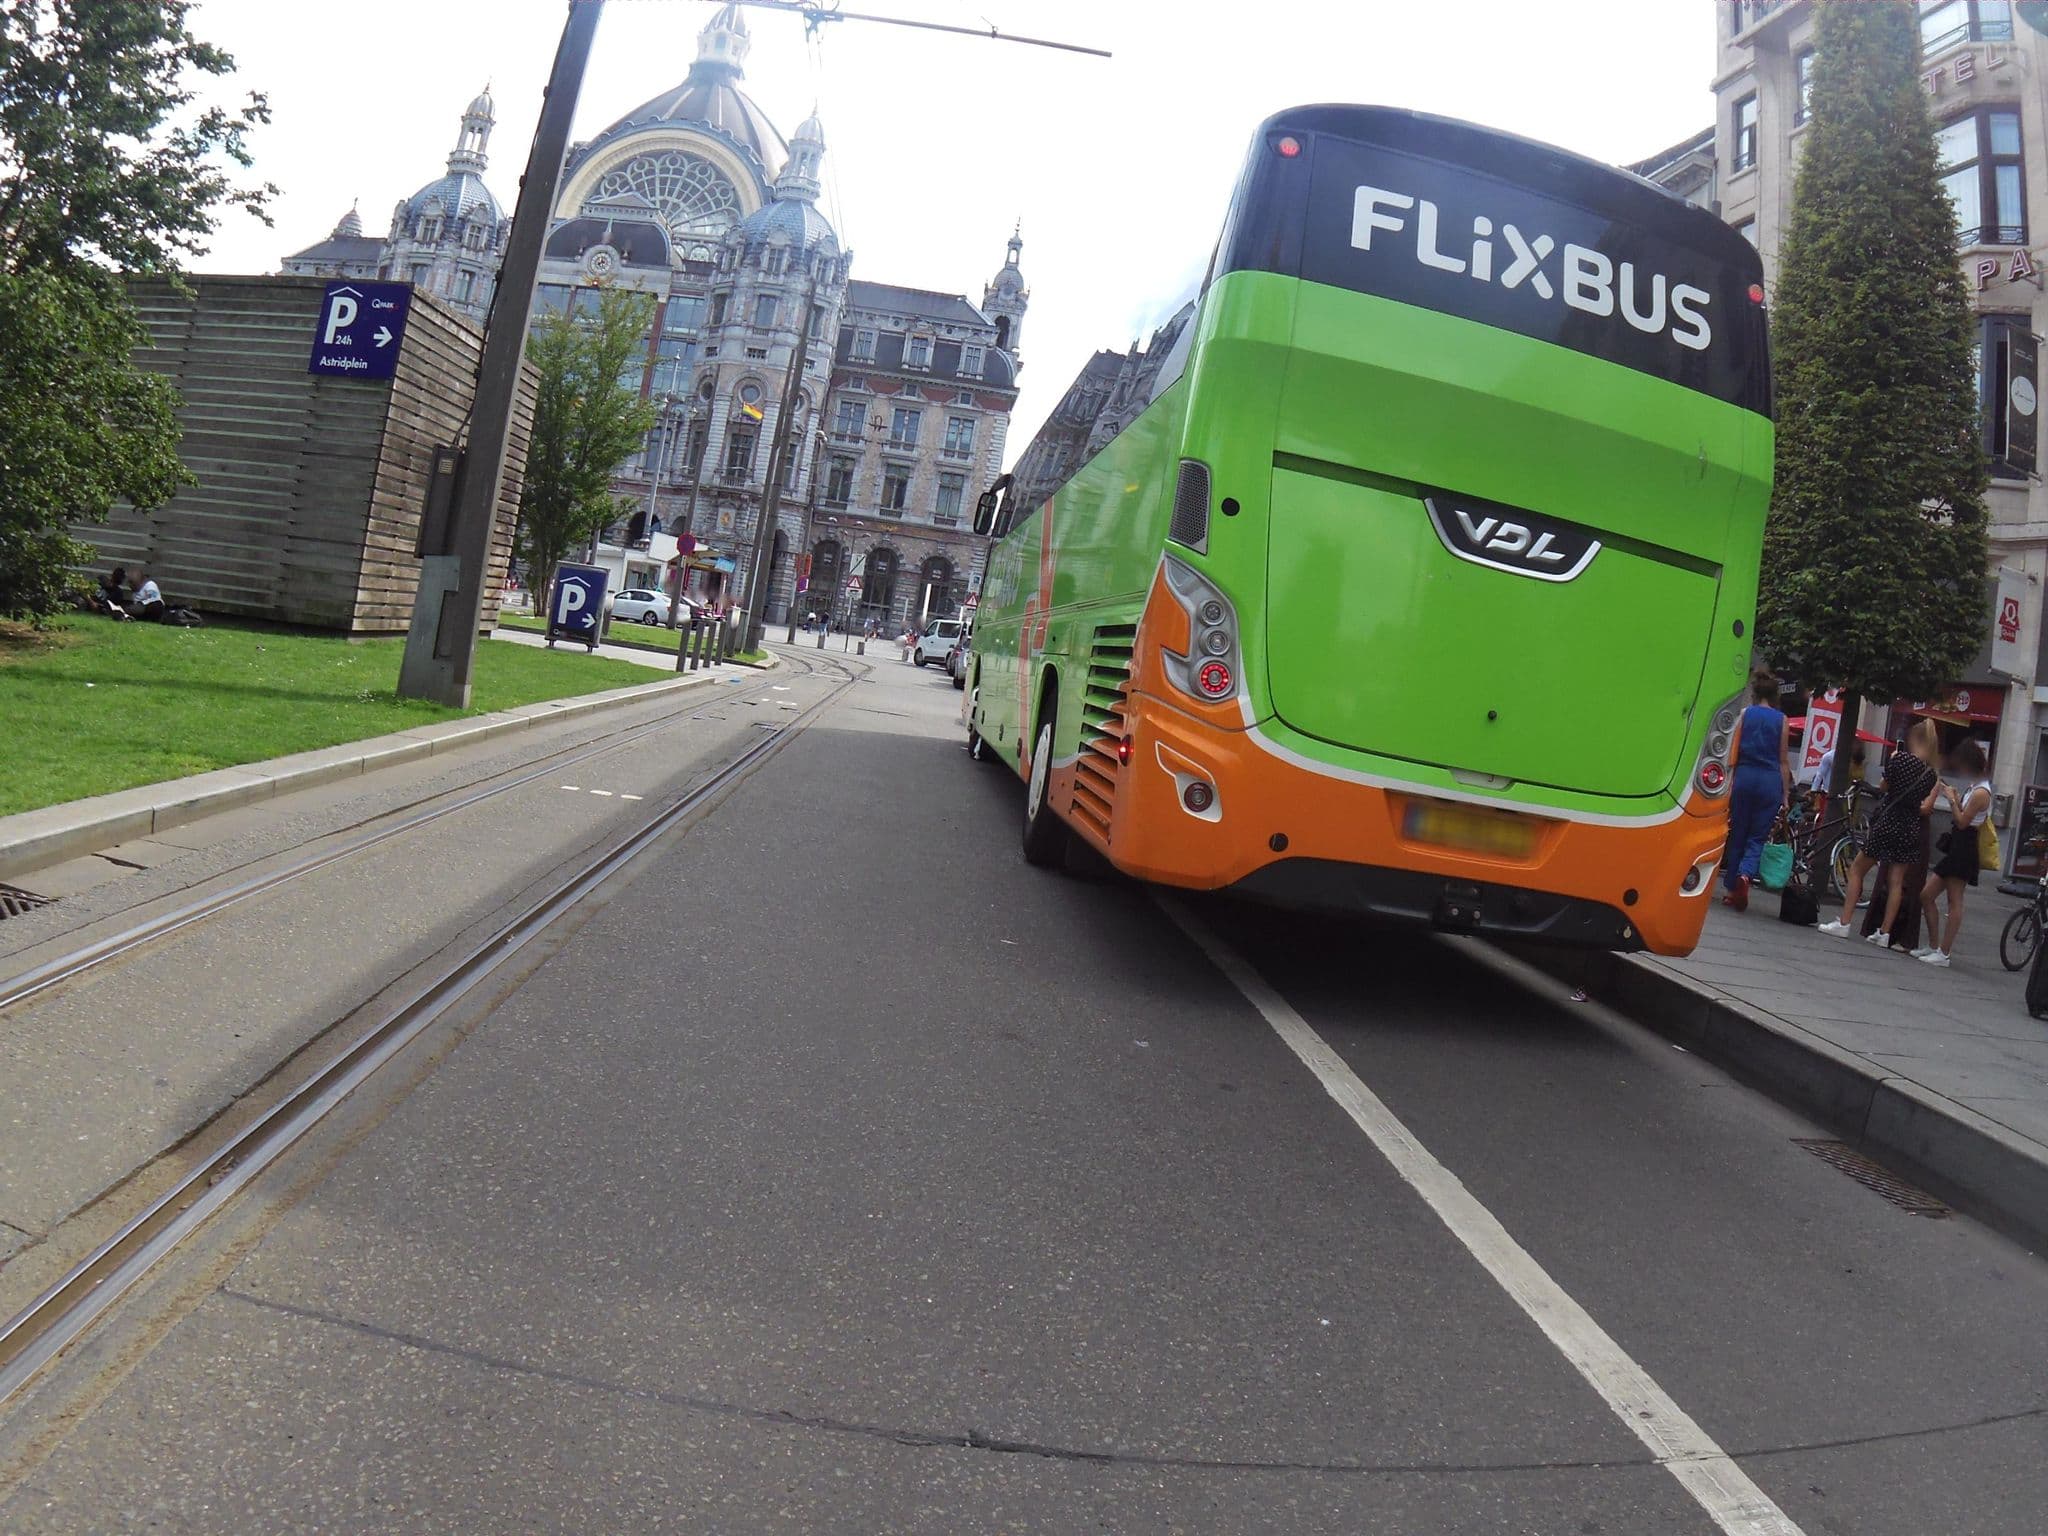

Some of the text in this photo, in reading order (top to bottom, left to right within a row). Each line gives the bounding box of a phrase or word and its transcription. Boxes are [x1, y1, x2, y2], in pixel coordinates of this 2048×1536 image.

[323, 296, 358, 344] P
[335, 335, 352, 345] 24h
[319, 356, 368, 370] Astridplein
[1454, 510, 1566, 563] VDL
[557, 583, 586, 624] P
[1811, 720, 1832, 754] Q
